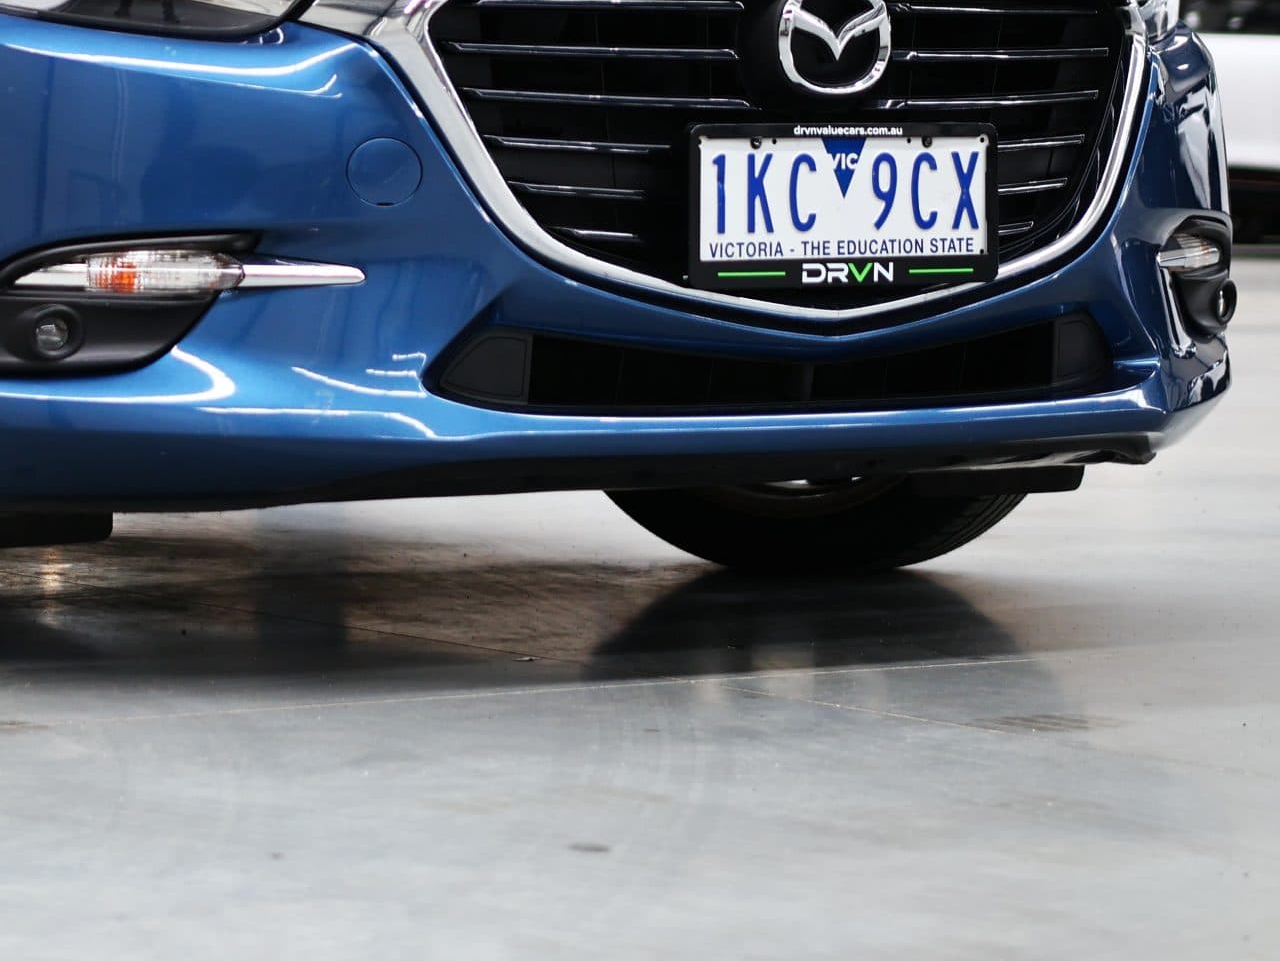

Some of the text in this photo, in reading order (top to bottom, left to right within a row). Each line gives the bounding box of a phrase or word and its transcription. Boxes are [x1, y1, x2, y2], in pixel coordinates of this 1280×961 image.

[793, 125, 903, 136] drvnvaluecars.com.au
[712, 151, 980, 234] 1KC 9CX
[708, 241, 785, 259] VICTORIA
[801, 240, 832, 257] THE
[836, 238, 925, 256] EDUCATION
[929, 237, 975, 254] STATE
[801, 261, 895, 284] DRVN
